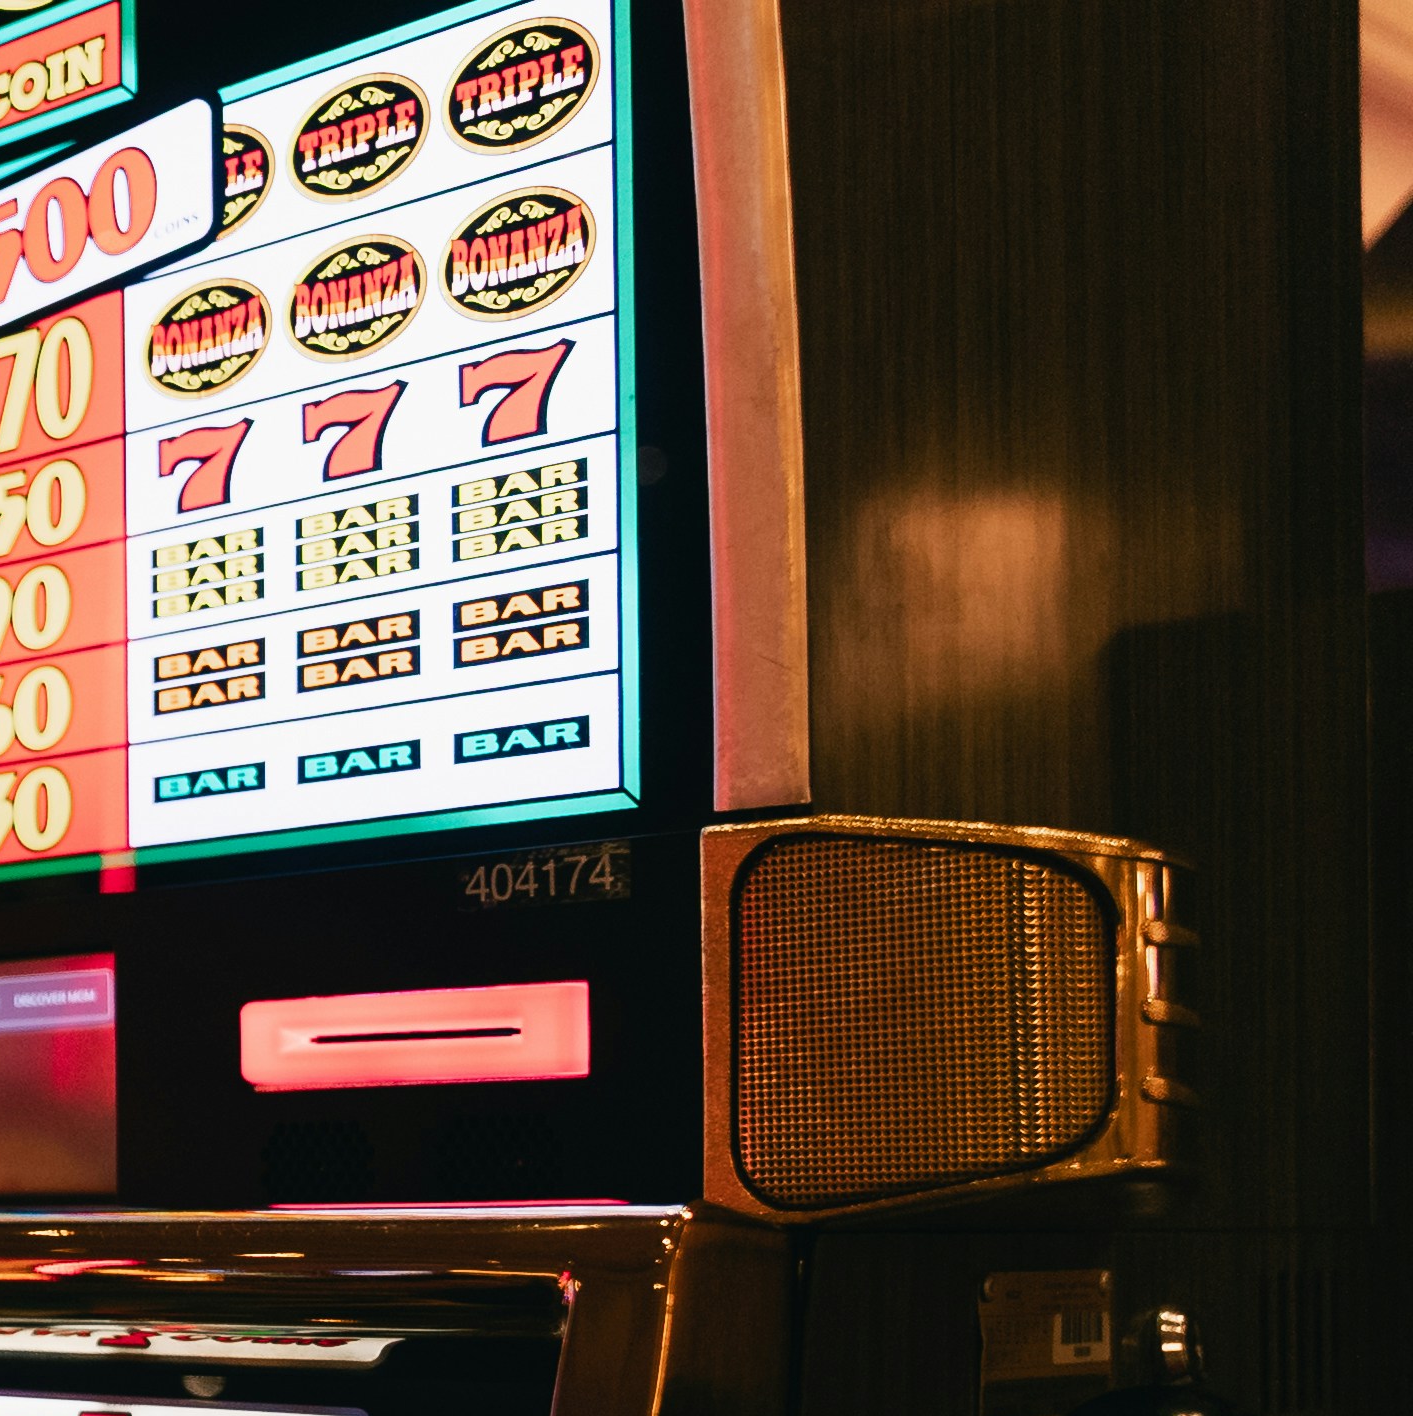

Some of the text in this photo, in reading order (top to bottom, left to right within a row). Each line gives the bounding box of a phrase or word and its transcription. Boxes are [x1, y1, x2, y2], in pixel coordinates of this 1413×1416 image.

[298, 45, 585, 172] TRIPLE TRIPLE
[151, 204, 585, 376] BONANZA BONANZA BONANZA
[158, 338, 577, 513] 7 7 7
[156, 461, 579, 568] BAR BAR BAR
[156, 490, 579, 593] BAR BAR BAR
[156, 518, 579, 618] BAR BAR BAR
[158, 585, 581, 680] BAR BAR BAR
[158, 622, 581, 712] BAR BAR BAR
[159, 722, 581, 798] BAR BAR BAR
[465, 854, 616, 902] 404174
